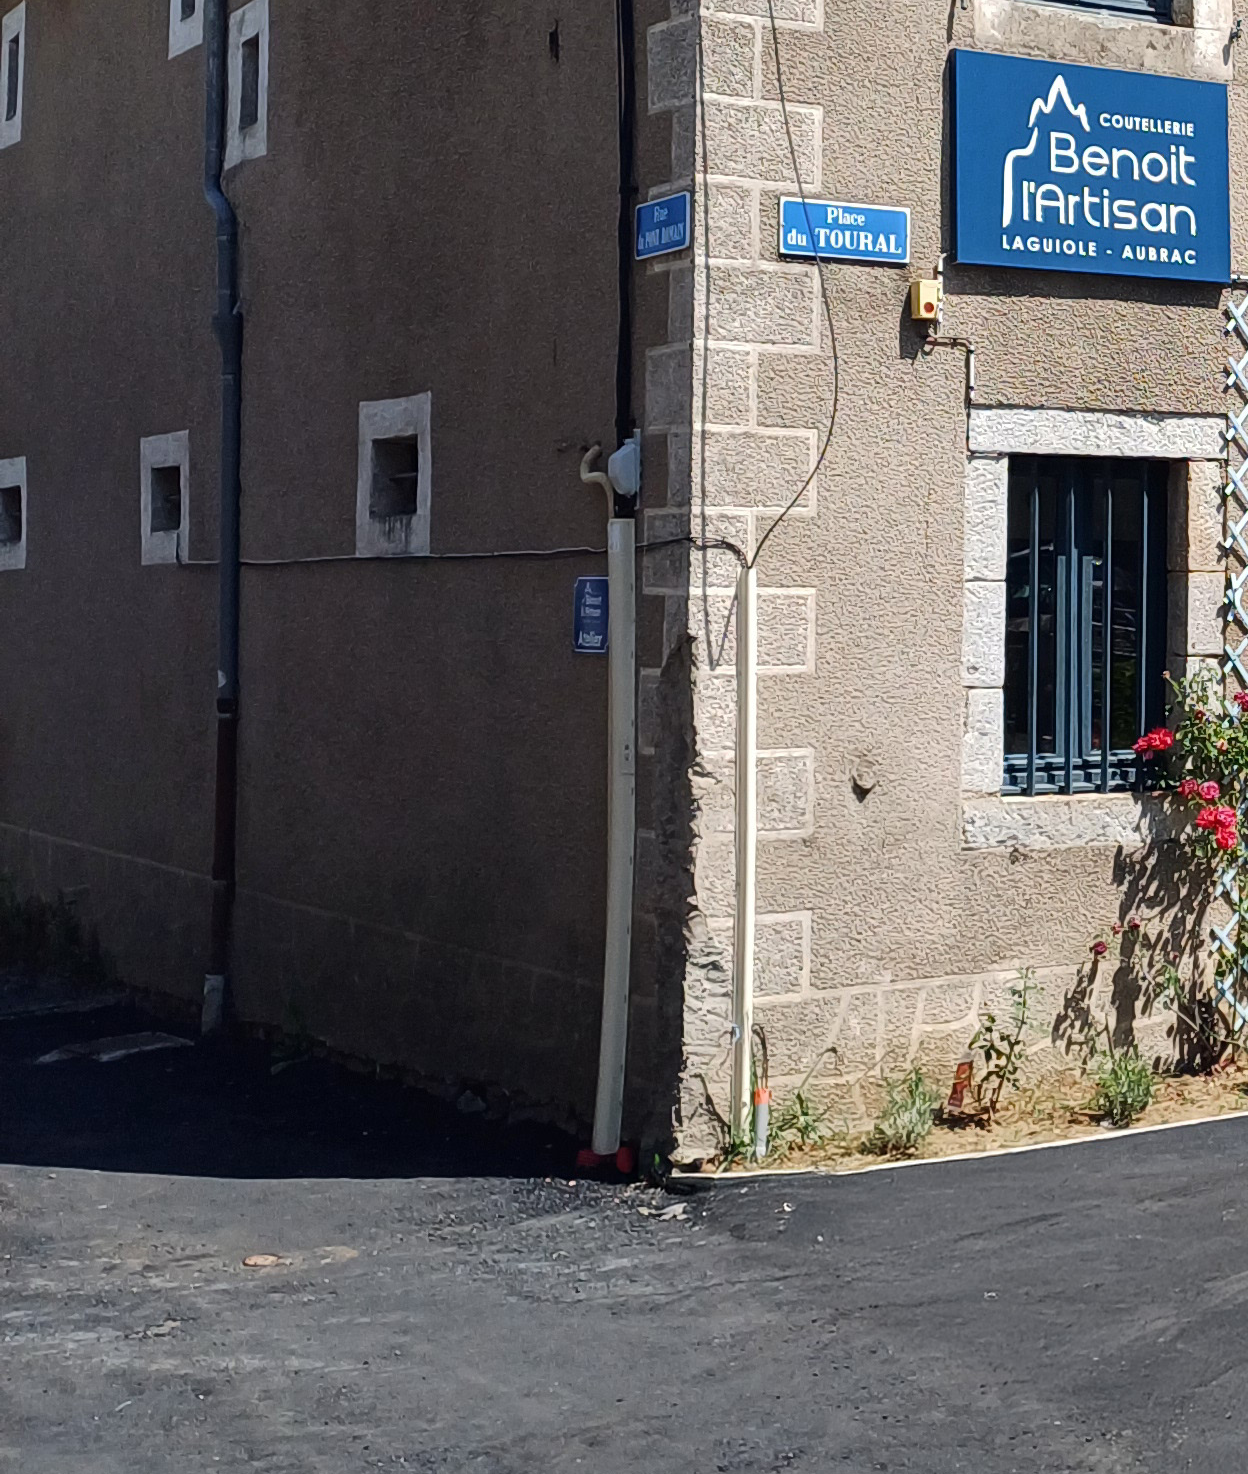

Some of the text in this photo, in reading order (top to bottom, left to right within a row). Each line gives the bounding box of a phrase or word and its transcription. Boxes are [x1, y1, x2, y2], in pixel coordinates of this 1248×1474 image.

[1099, 112, 1195, 137] COUTELLERIE
[1050, 130, 1197, 186] Benoit
[653, 205, 669, 223] Rue
[825, 206, 866, 226] Place
[1022, 180, 1197, 237] l'Artisan
[787, 227, 902, 254] du TOURAL
[1002, 234, 1097, 257] LAGUIOLE
[1121, 244, 1197, 265] AUBRAC
